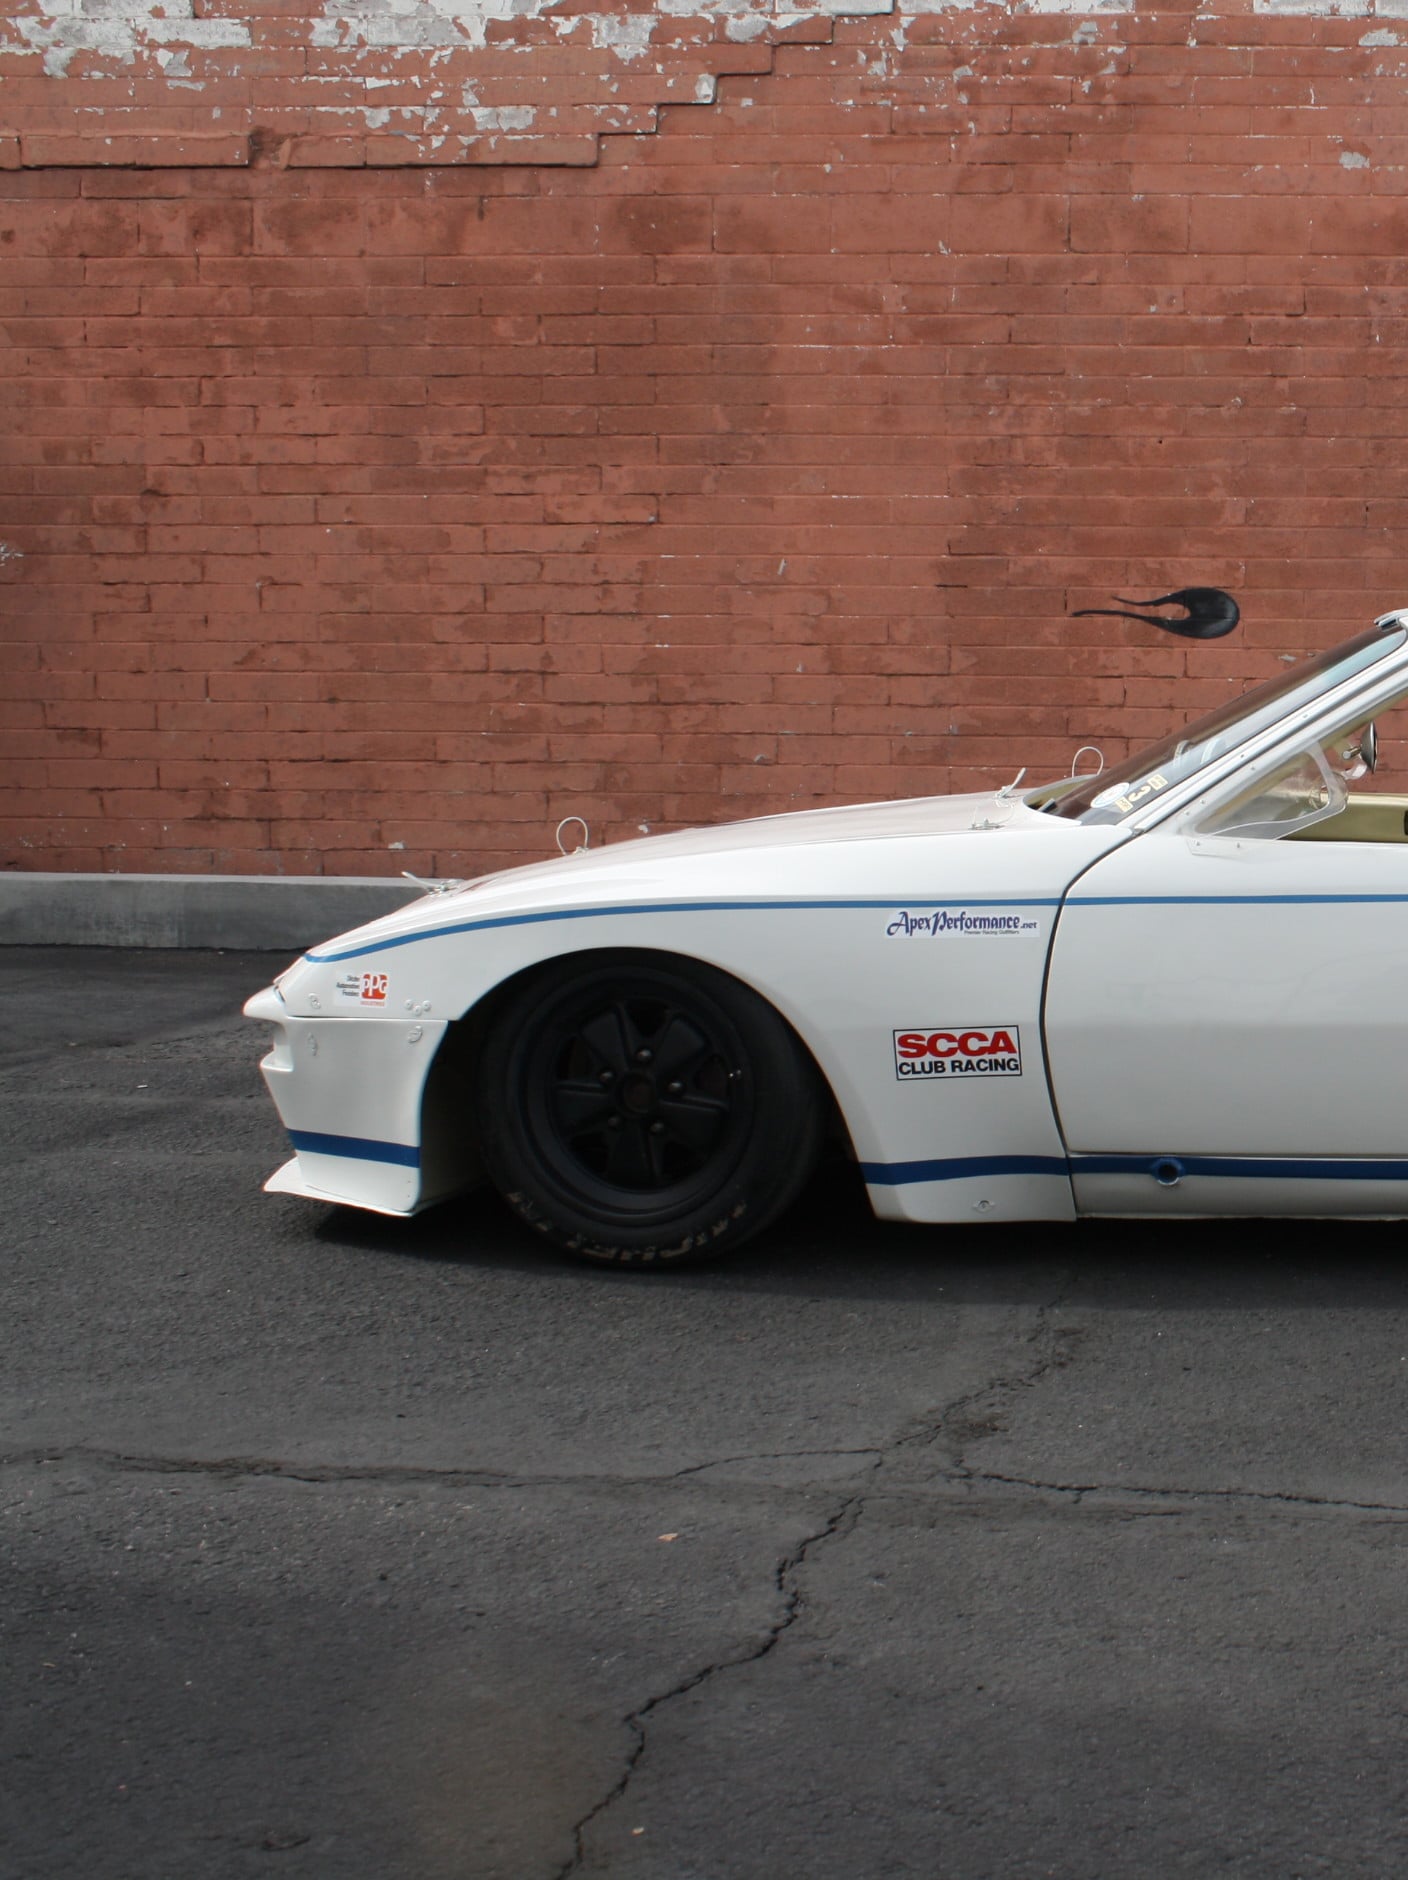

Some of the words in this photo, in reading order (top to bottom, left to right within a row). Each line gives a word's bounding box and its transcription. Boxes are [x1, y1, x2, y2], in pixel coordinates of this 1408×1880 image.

[897, 1030, 1018, 1059] SCCA
[898, 1060, 946, 1075] CLUB
[950, 1058, 1020, 1073] RACING
